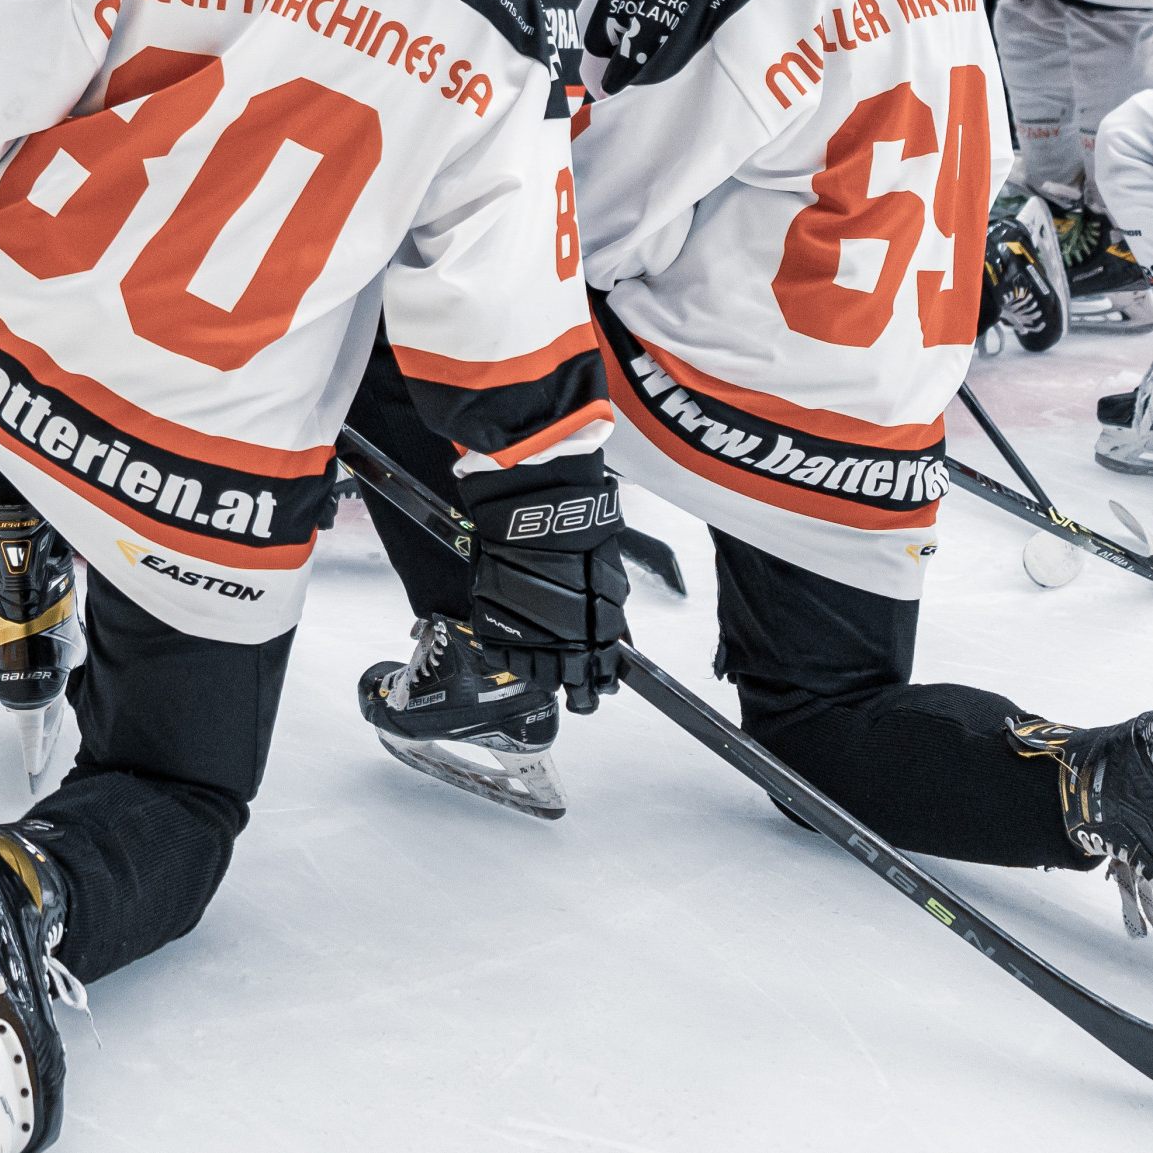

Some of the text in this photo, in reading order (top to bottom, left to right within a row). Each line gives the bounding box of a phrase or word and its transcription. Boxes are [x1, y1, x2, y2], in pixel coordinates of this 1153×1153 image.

[440, 60, 493, 118] SA
[555, 166, 579, 283] 8
[771, 64, 992, 349] 69
[140, 553, 266, 603] EASTON
[483, 613, 523, 639] VAPOR
[1, 670, 52, 682] BAUER
